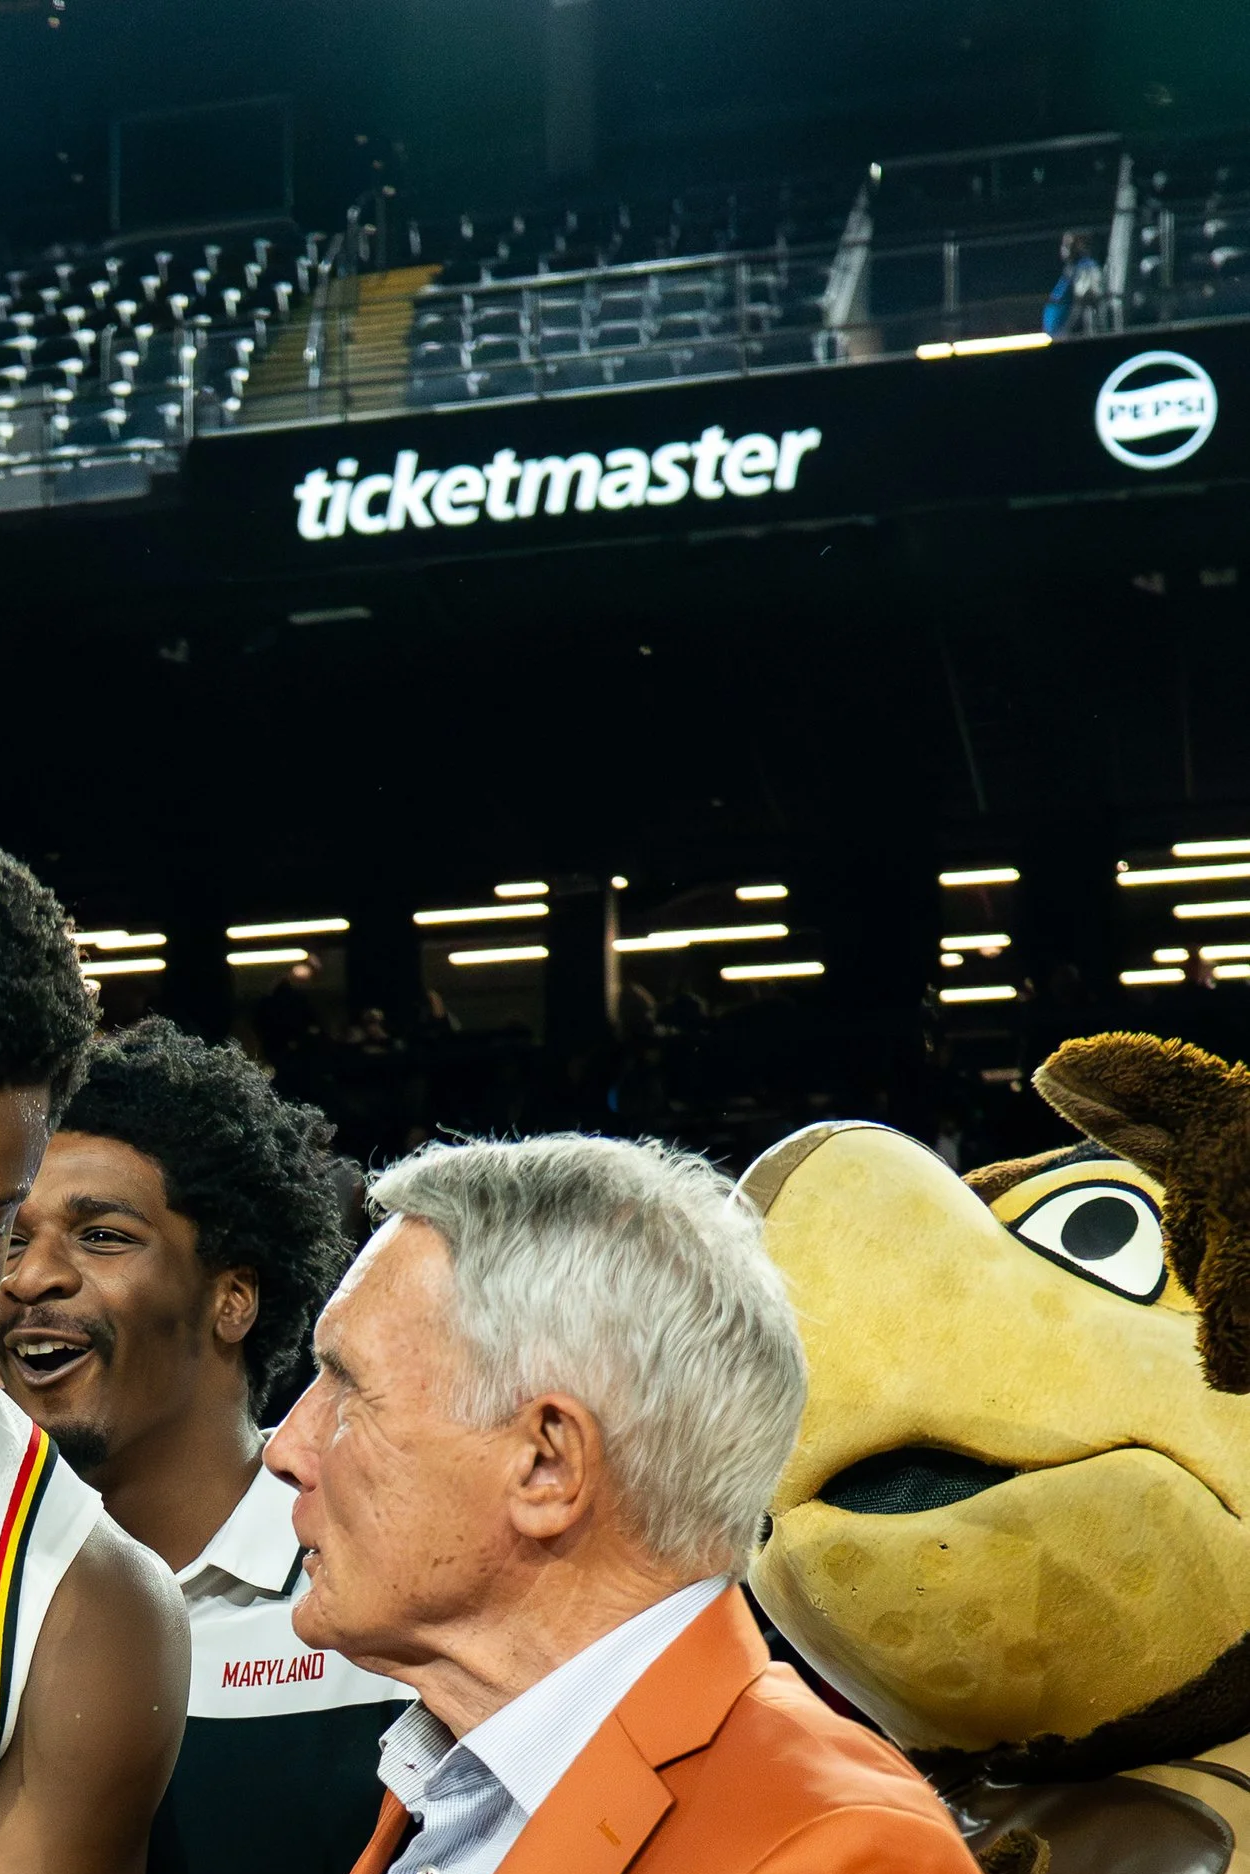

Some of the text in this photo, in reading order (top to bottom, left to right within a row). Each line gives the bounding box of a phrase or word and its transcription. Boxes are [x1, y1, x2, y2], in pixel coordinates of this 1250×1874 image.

[1107, 397, 1206, 422] PEPSI
[293, 424, 822, 541] ticketmaster
[221, 1652, 325, 1689] MARYLAND
